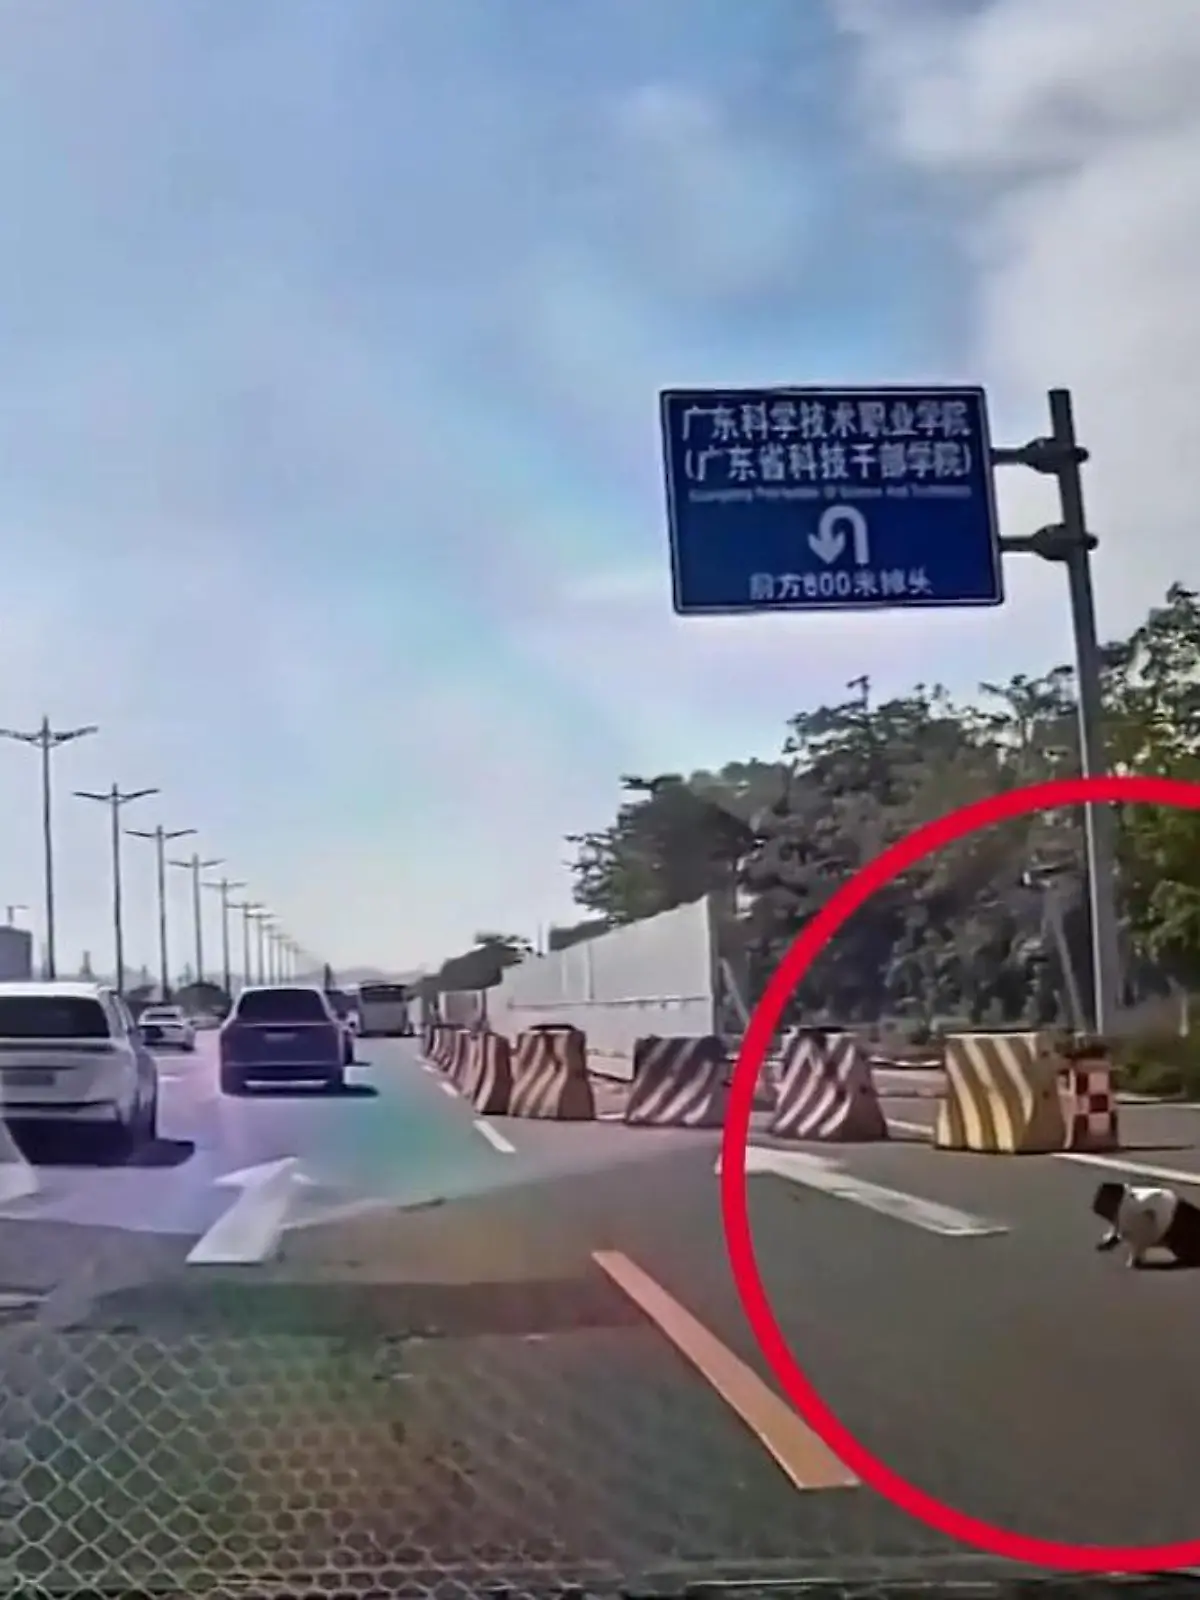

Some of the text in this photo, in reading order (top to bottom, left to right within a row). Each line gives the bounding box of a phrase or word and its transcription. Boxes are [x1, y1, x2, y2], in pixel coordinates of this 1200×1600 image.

[682, 401, 972, 440] 广东科学技术职业学院
